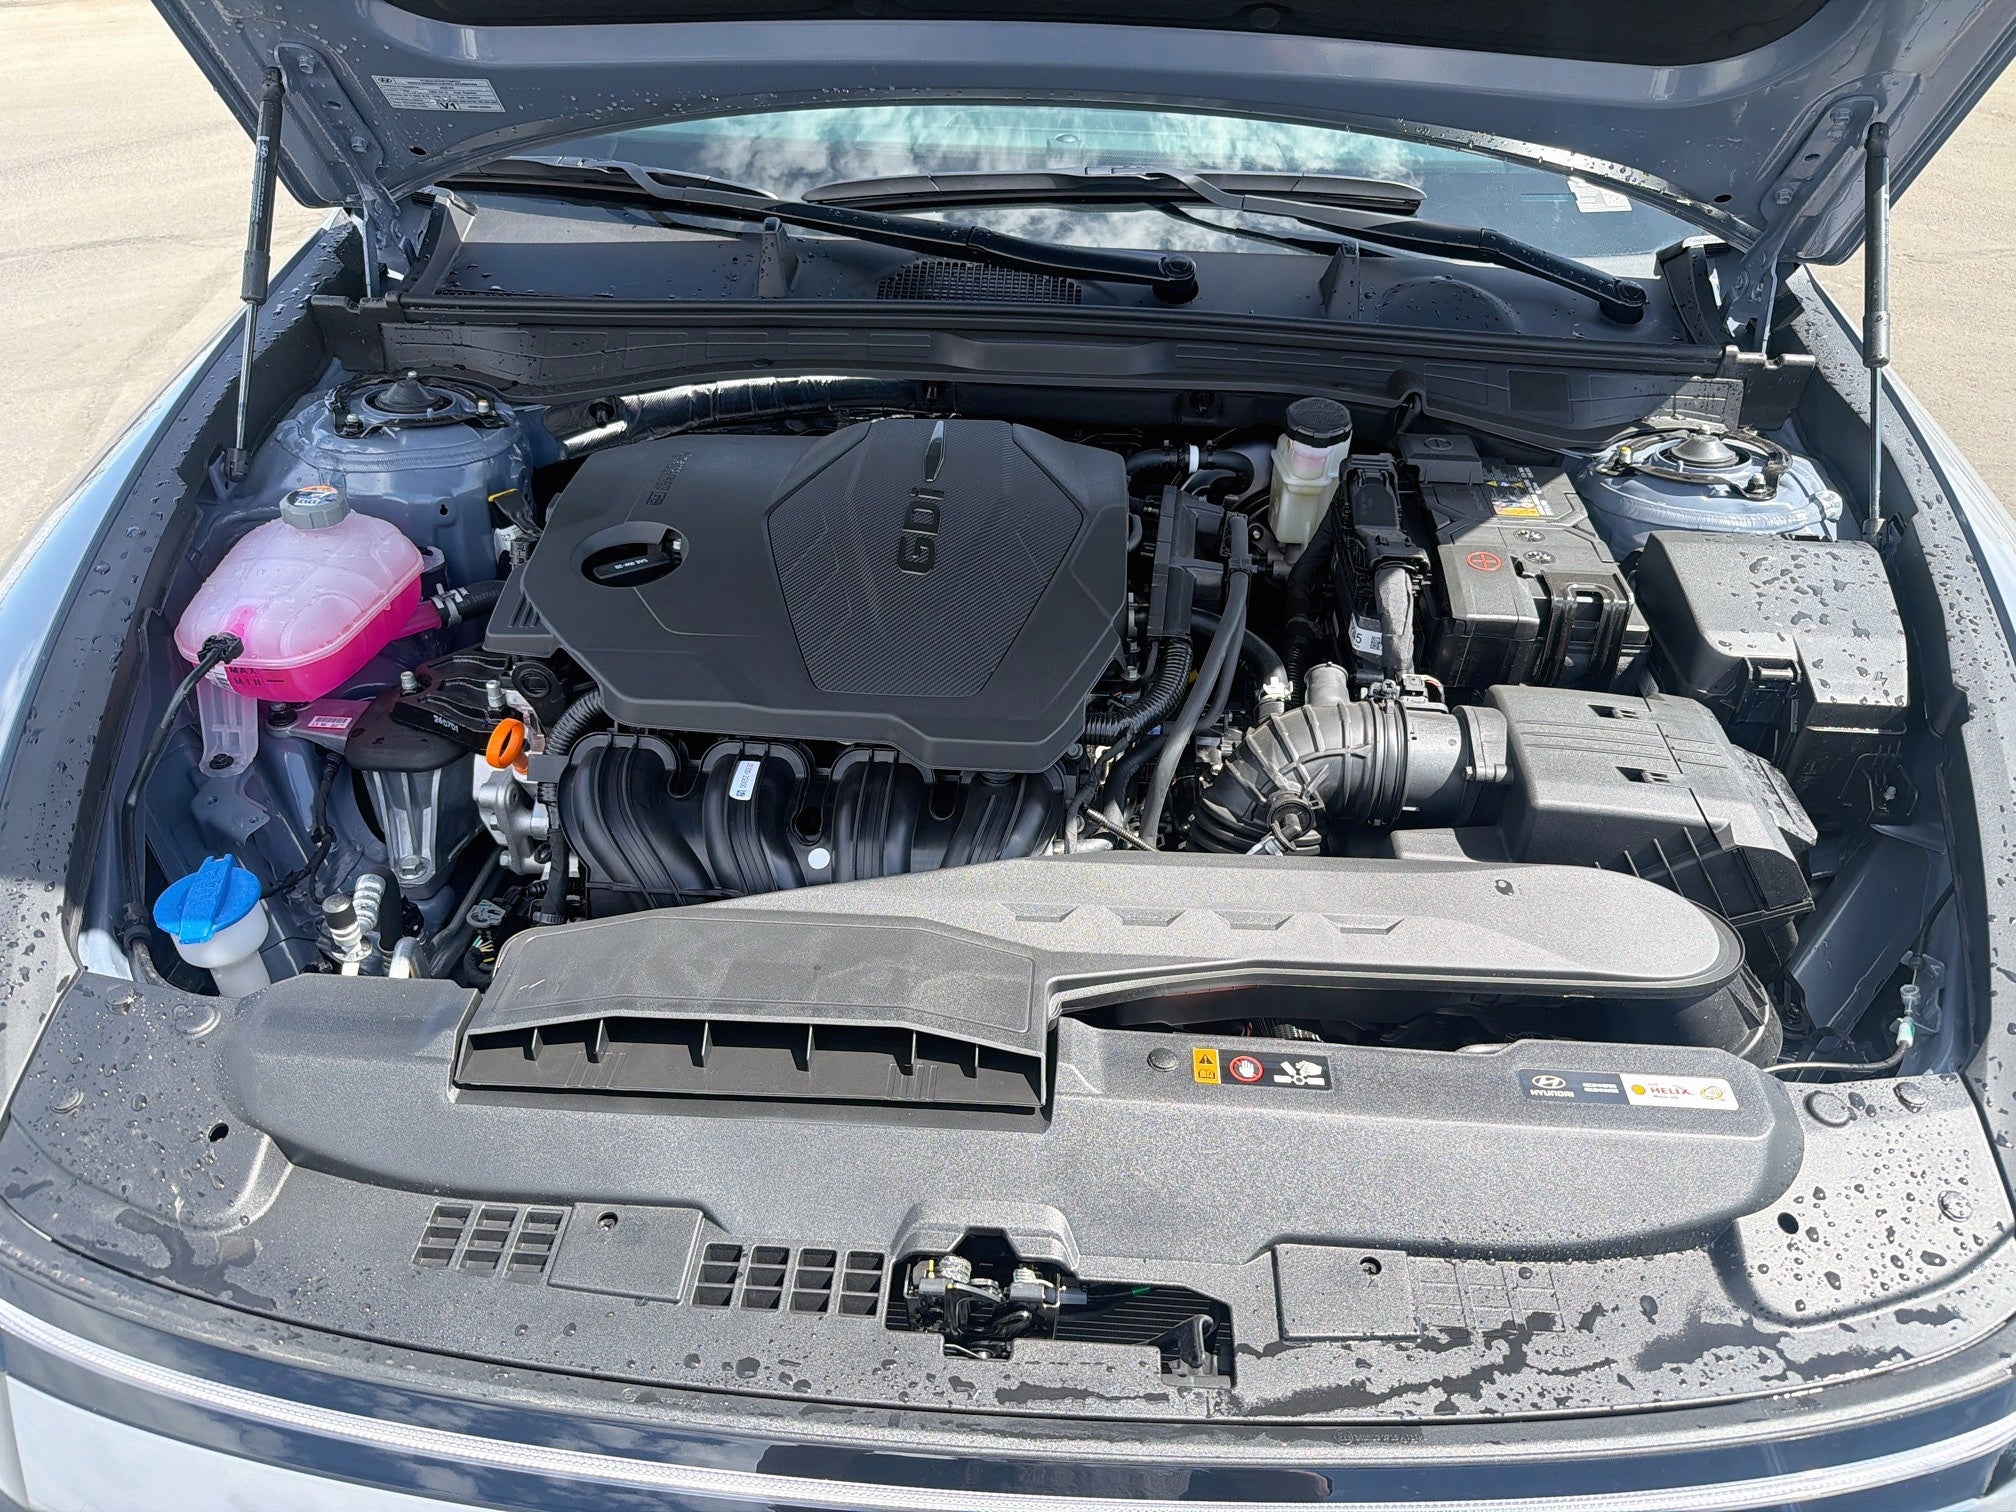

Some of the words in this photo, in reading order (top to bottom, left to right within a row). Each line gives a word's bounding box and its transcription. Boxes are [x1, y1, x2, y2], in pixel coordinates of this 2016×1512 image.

[439, 102, 458, 110] V1
[228, 666, 257, 675] MAX
[234, 677, 262, 686] MIN
[1530, 1088, 1575, 1098] HYUNDAI
[1651, 1086, 1691, 1095] HELIX
